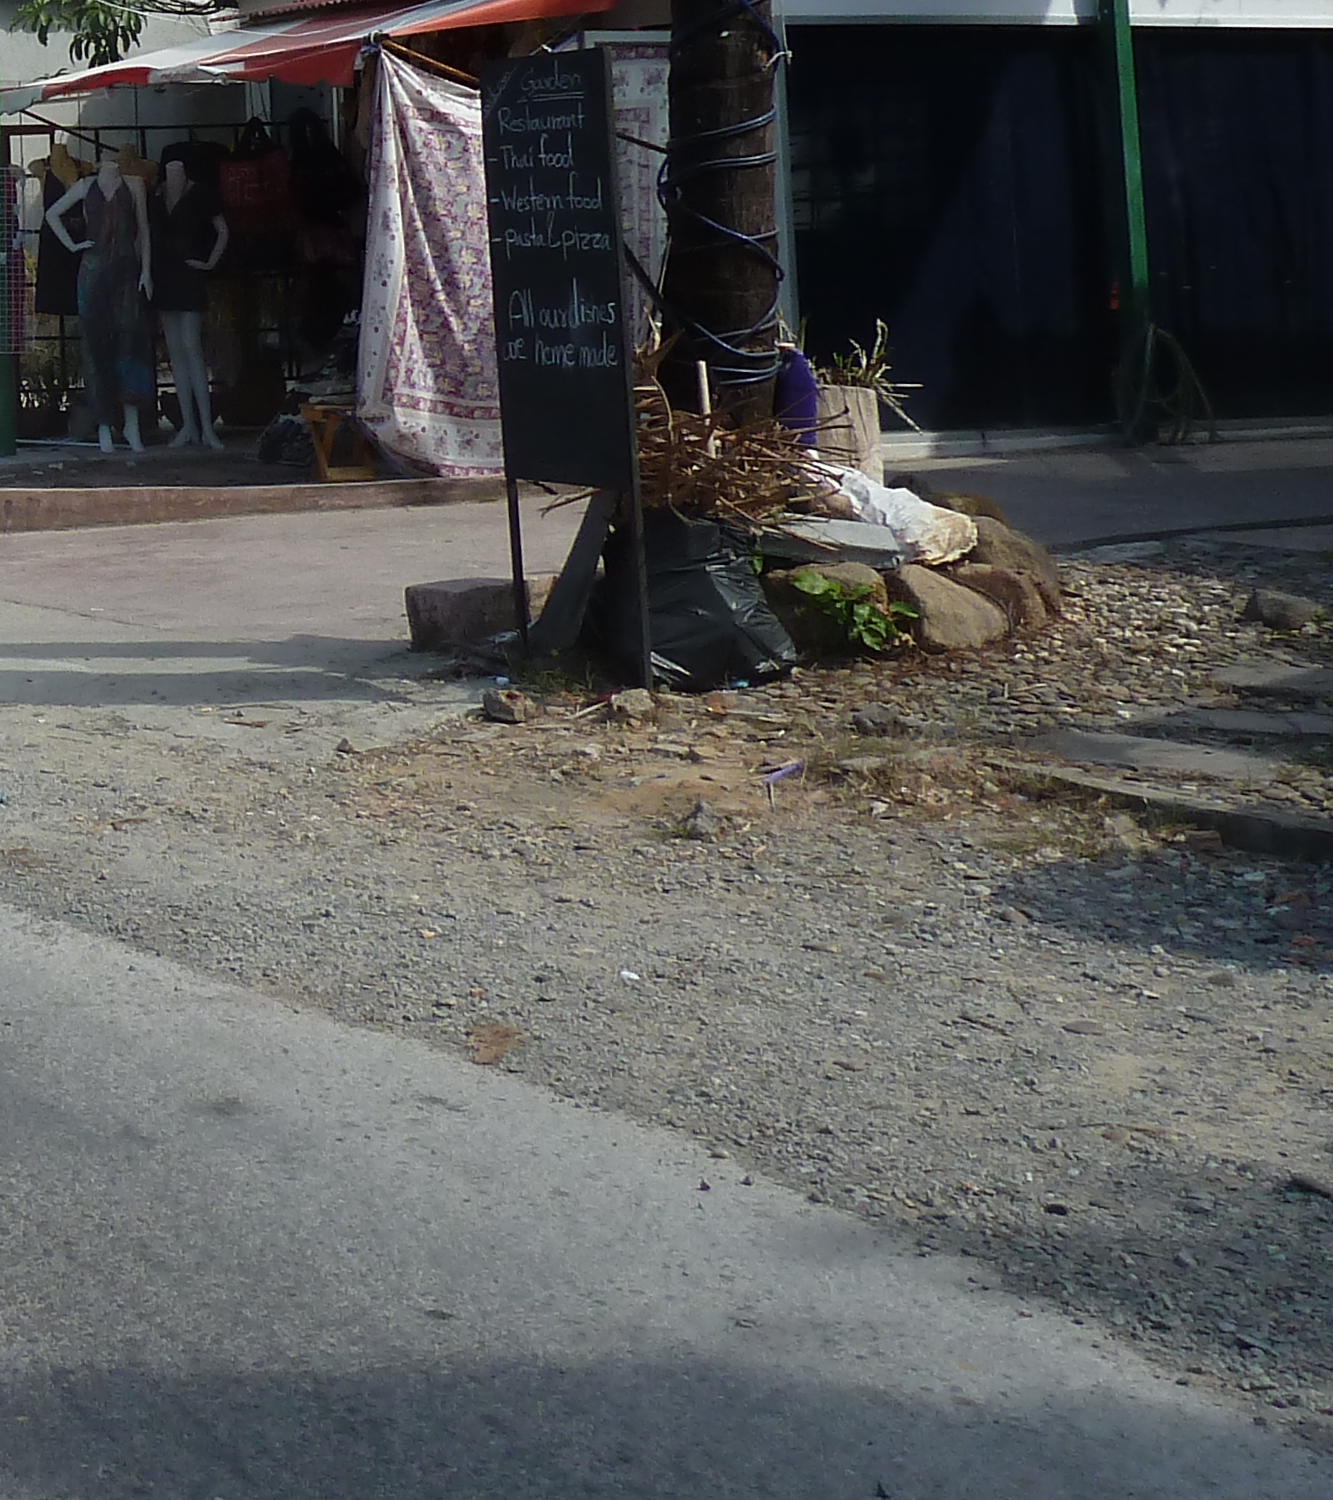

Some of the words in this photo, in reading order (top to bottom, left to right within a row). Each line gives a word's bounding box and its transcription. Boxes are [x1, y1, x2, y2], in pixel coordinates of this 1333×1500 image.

[497, 102, 586, 134] Restaurant
[538, 132, 574, 168] food
[566, 171, 603, 211] food
[561, 225, 611, 261] pizza
[508, 288, 534, 331] All
